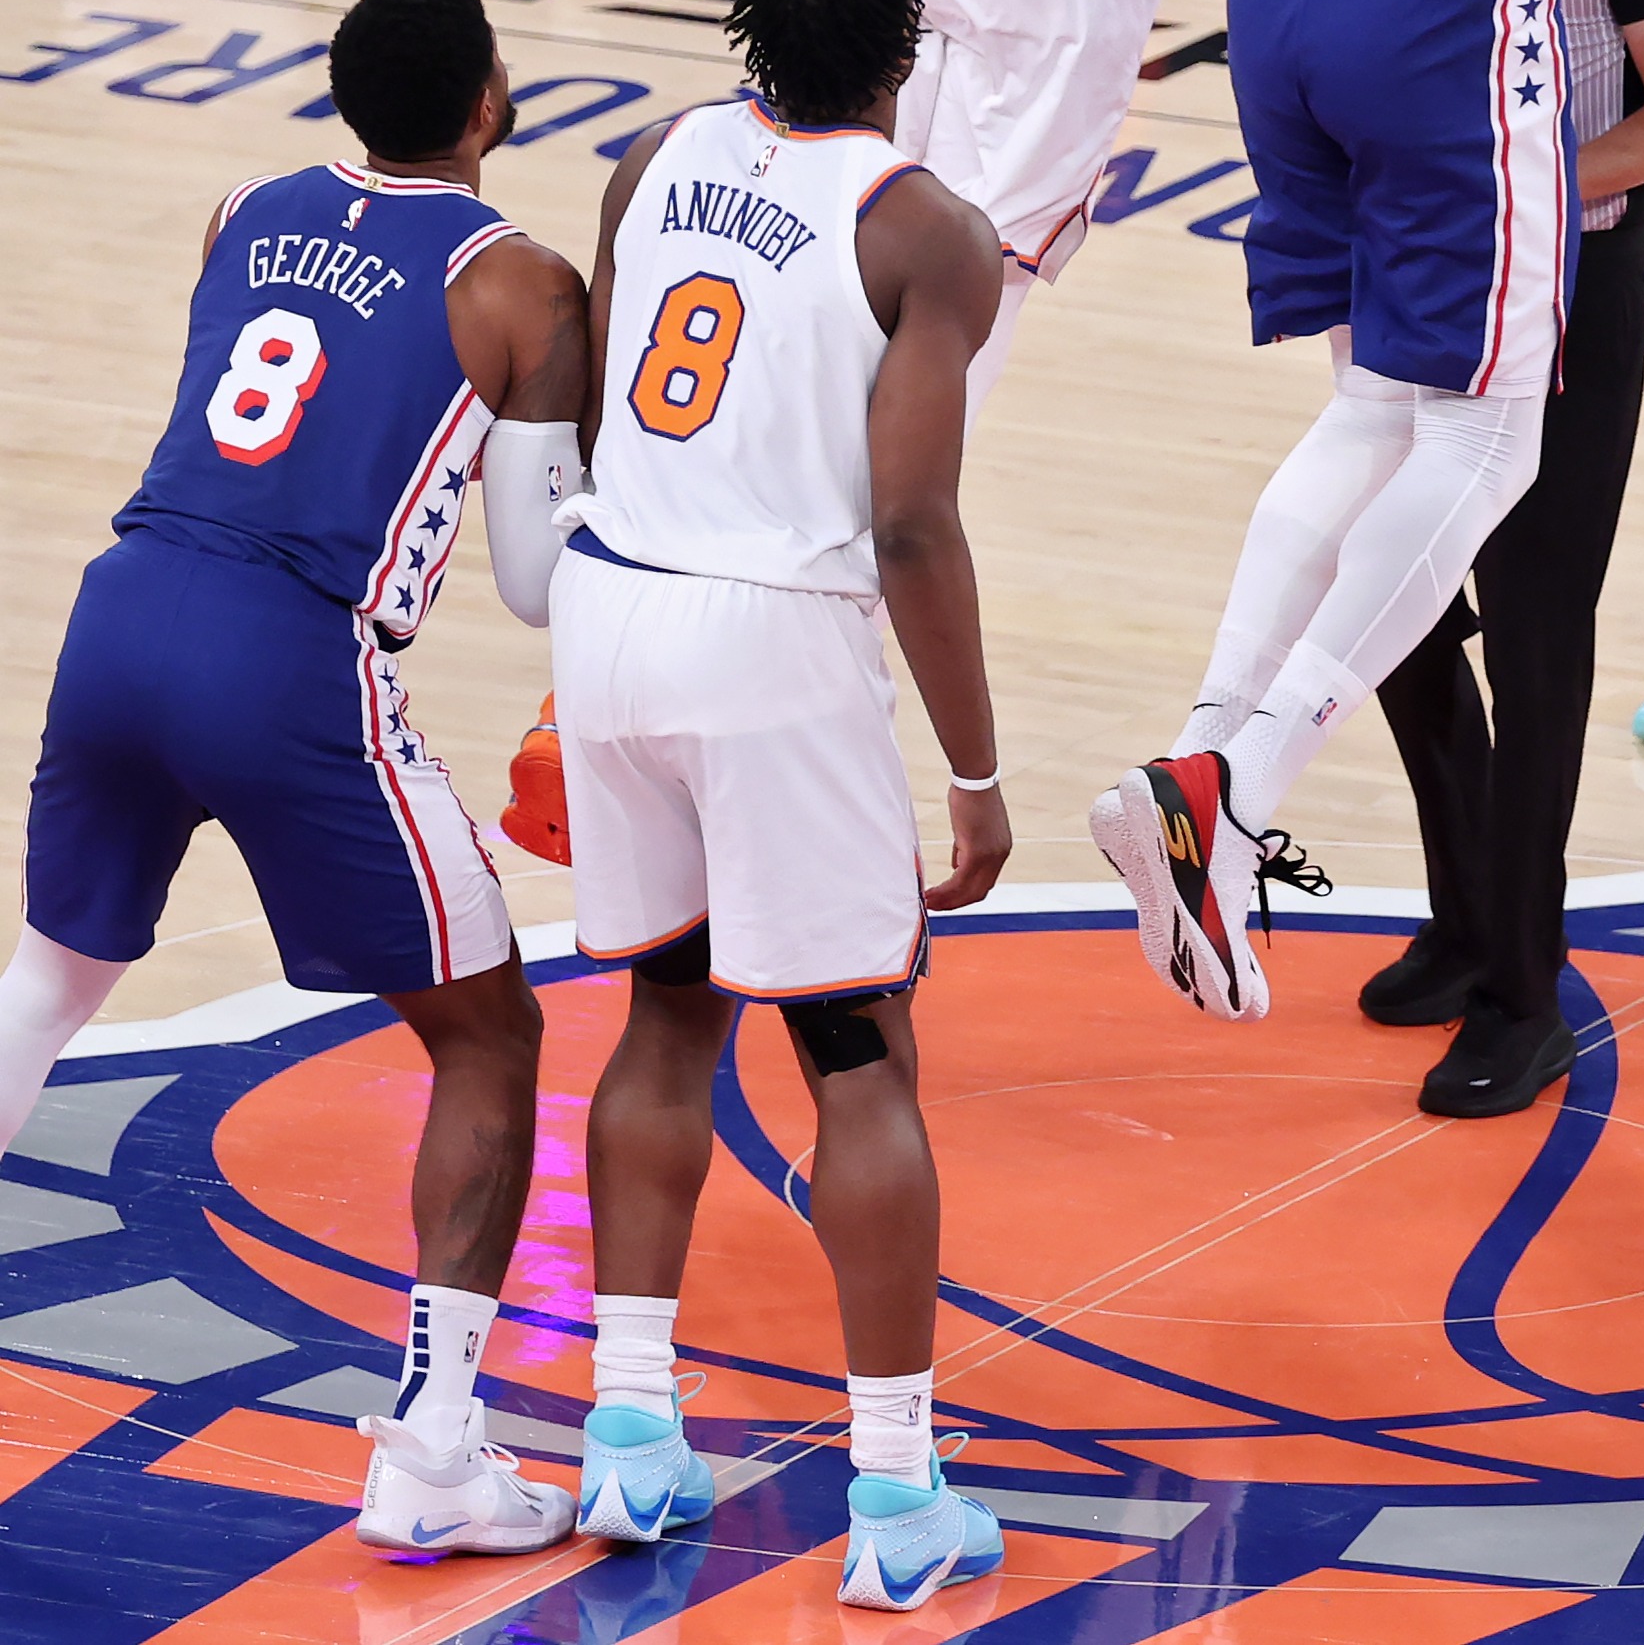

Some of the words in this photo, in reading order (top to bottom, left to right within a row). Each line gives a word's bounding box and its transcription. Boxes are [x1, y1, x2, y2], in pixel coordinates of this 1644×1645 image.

[248, 234, 406, 320] GEORGE
[660, 180, 817, 273] ANUNOBY
[205, 307, 328, 467] 8
[627, 270, 745, 443] 8
